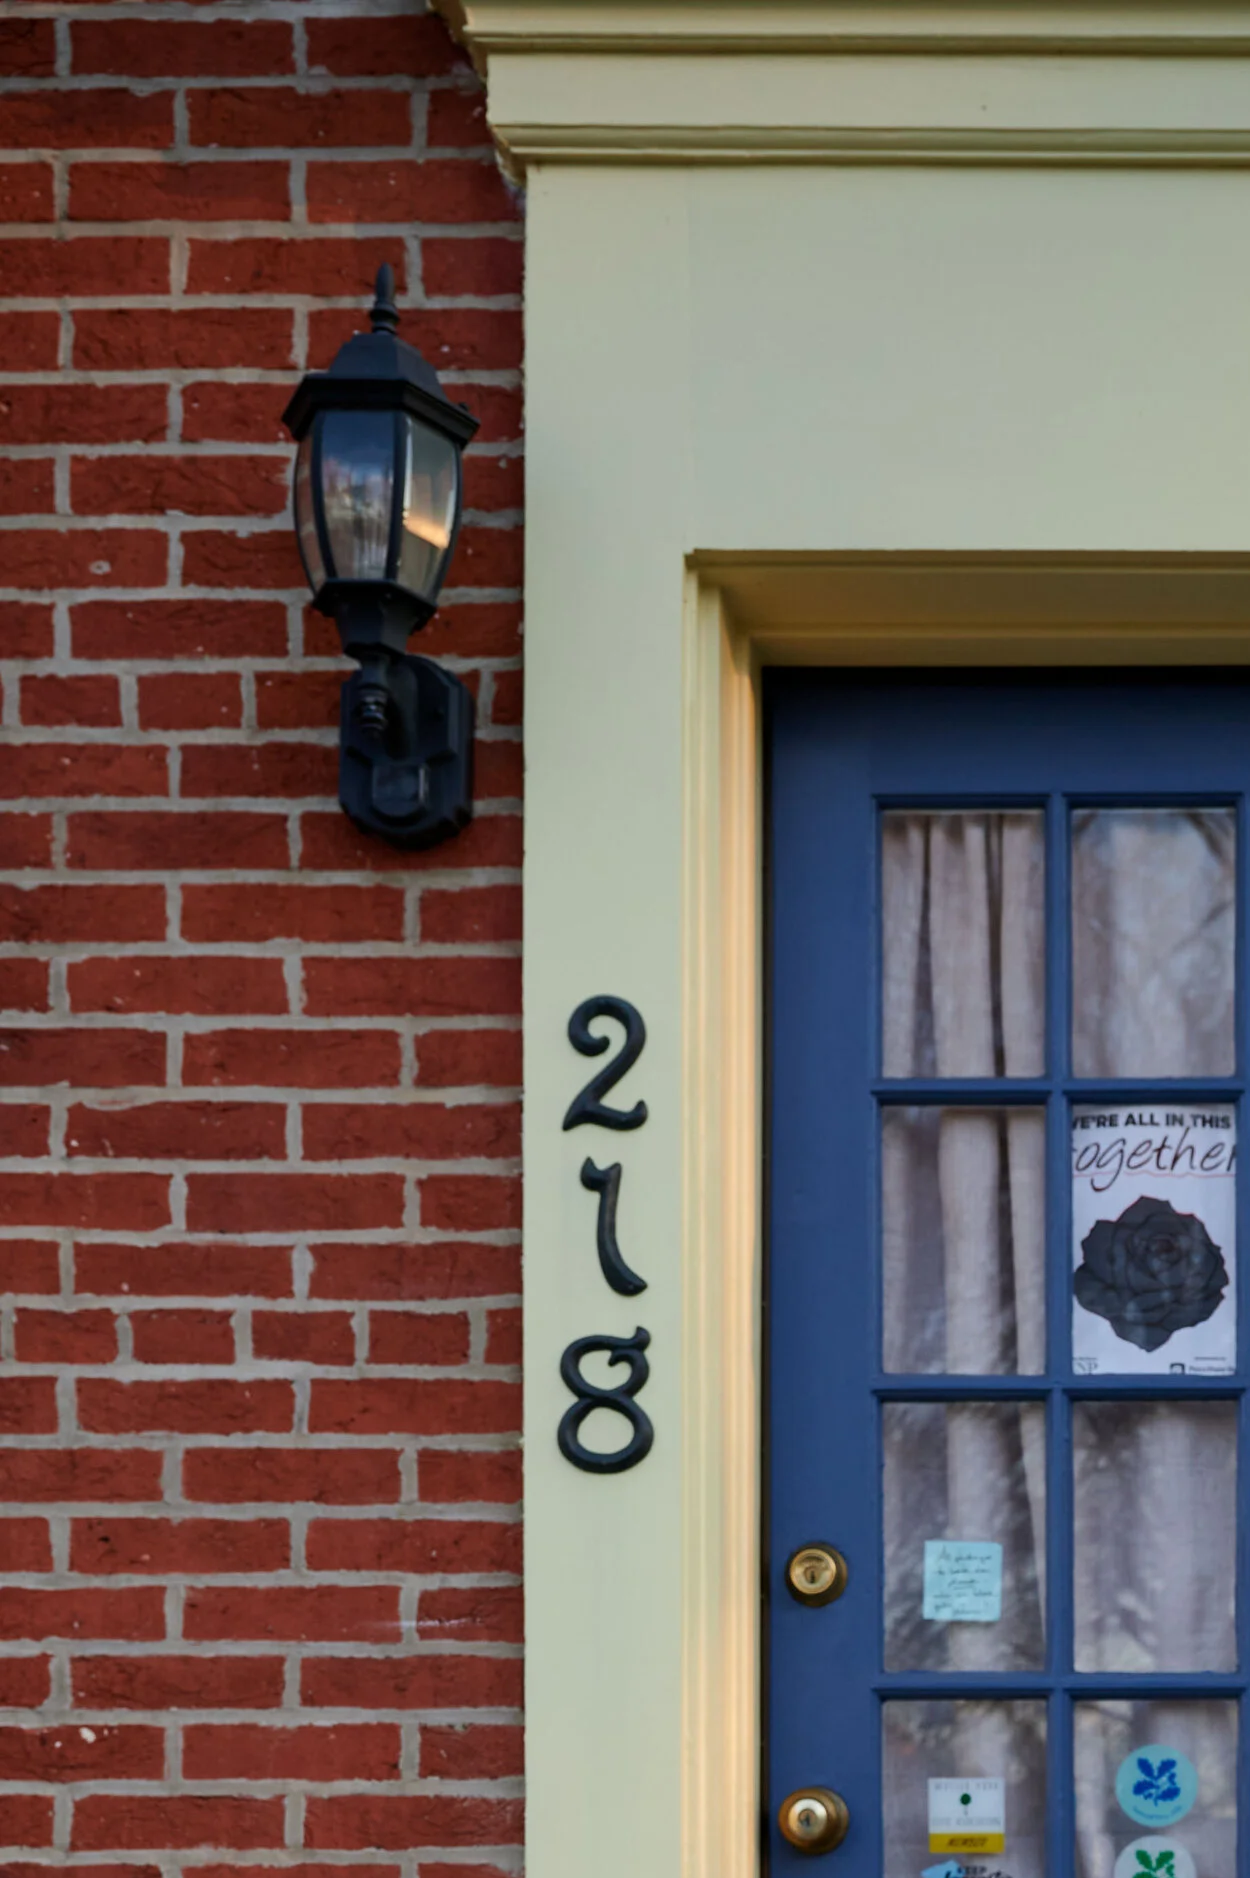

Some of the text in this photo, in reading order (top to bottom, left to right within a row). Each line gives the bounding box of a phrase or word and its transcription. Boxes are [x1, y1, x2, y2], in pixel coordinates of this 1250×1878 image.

[1125, 1112, 1159, 1127] ALL
[1165, 1112, 1184, 1127] IN
[1190, 1113, 1231, 1129] THIS
[1073, 1126, 1236, 1192] ogether
[557, 995, 654, 1474] 218
